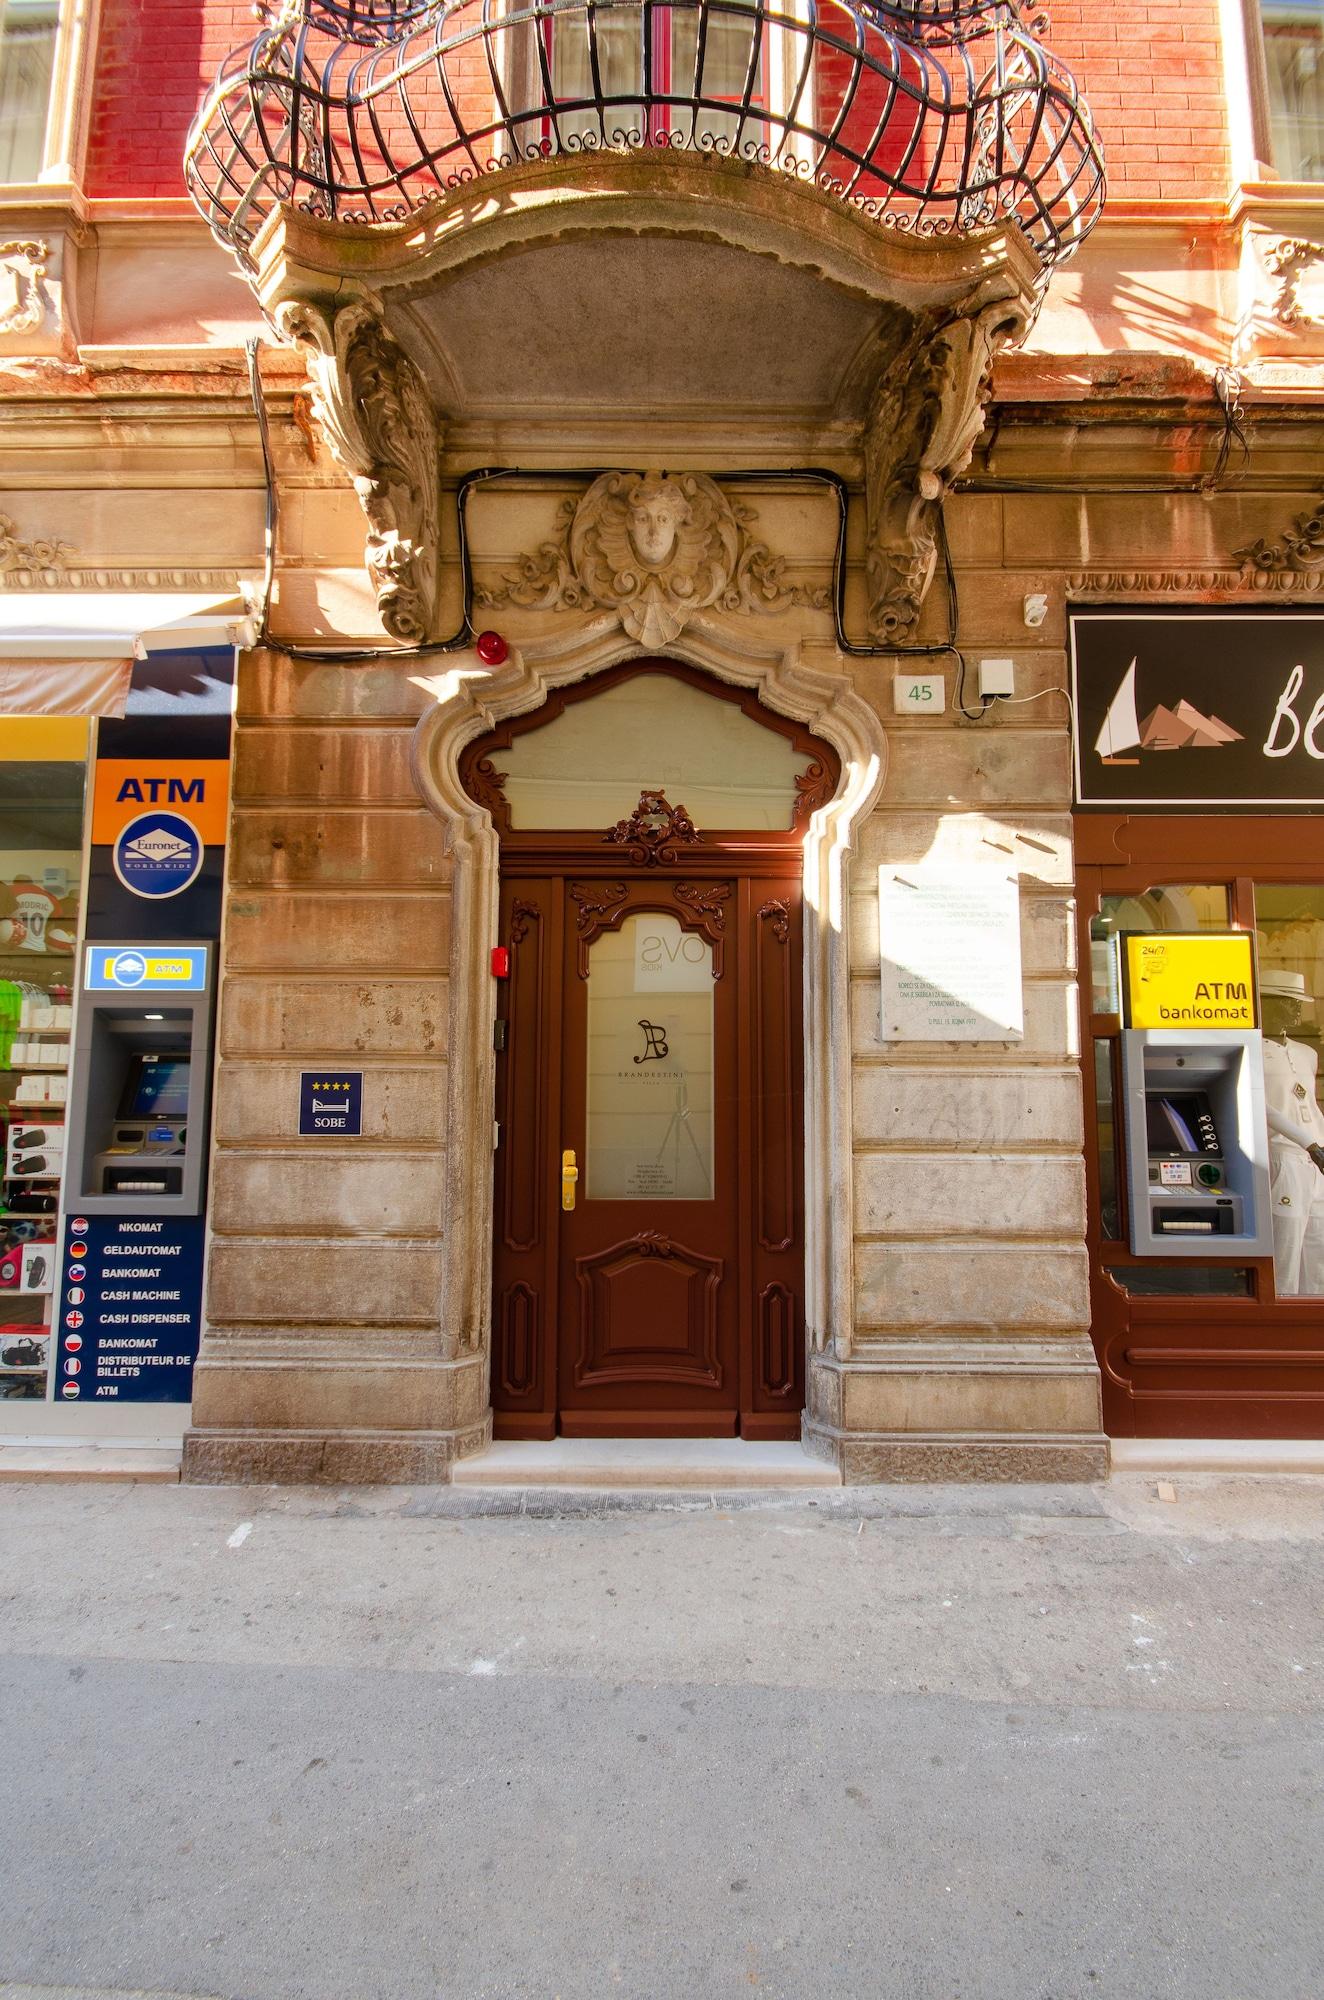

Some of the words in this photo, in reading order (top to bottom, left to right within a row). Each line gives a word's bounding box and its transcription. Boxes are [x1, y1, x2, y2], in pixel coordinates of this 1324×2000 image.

[908, 685, 932, 700] 45
[116, 778, 206, 803] ATM
[137, 839, 181, 850] Euronet
[1142, 946, 1165, 955] 24/7
[1195, 982, 1247, 1000] ATM
[1160, 1004, 1249, 1018] bankomat
[314, 1117, 346, 1127] SOBE
[119, 1223, 163, 1232] NKOMAT
[103, 1245, 181, 1255] GELDAUTOMAT
[102, 1268, 161, 1278] BANKOMAT
[101, 1291, 130, 1300] CASH
[132, 1291, 181, 1300] MACHINE
[100, 1314, 129, 1323] CASH
[131, 1314, 191, 1323] DISPENSER
[98, 1339, 158, 1348] BANKOMAT
[98, 1356, 174, 1365] DISTRIBUTEUR
[176, 1356, 191, 1365] DE
[97, 1367, 140, 1376] BILLETS
[96, 1386, 118, 1395] ATM
